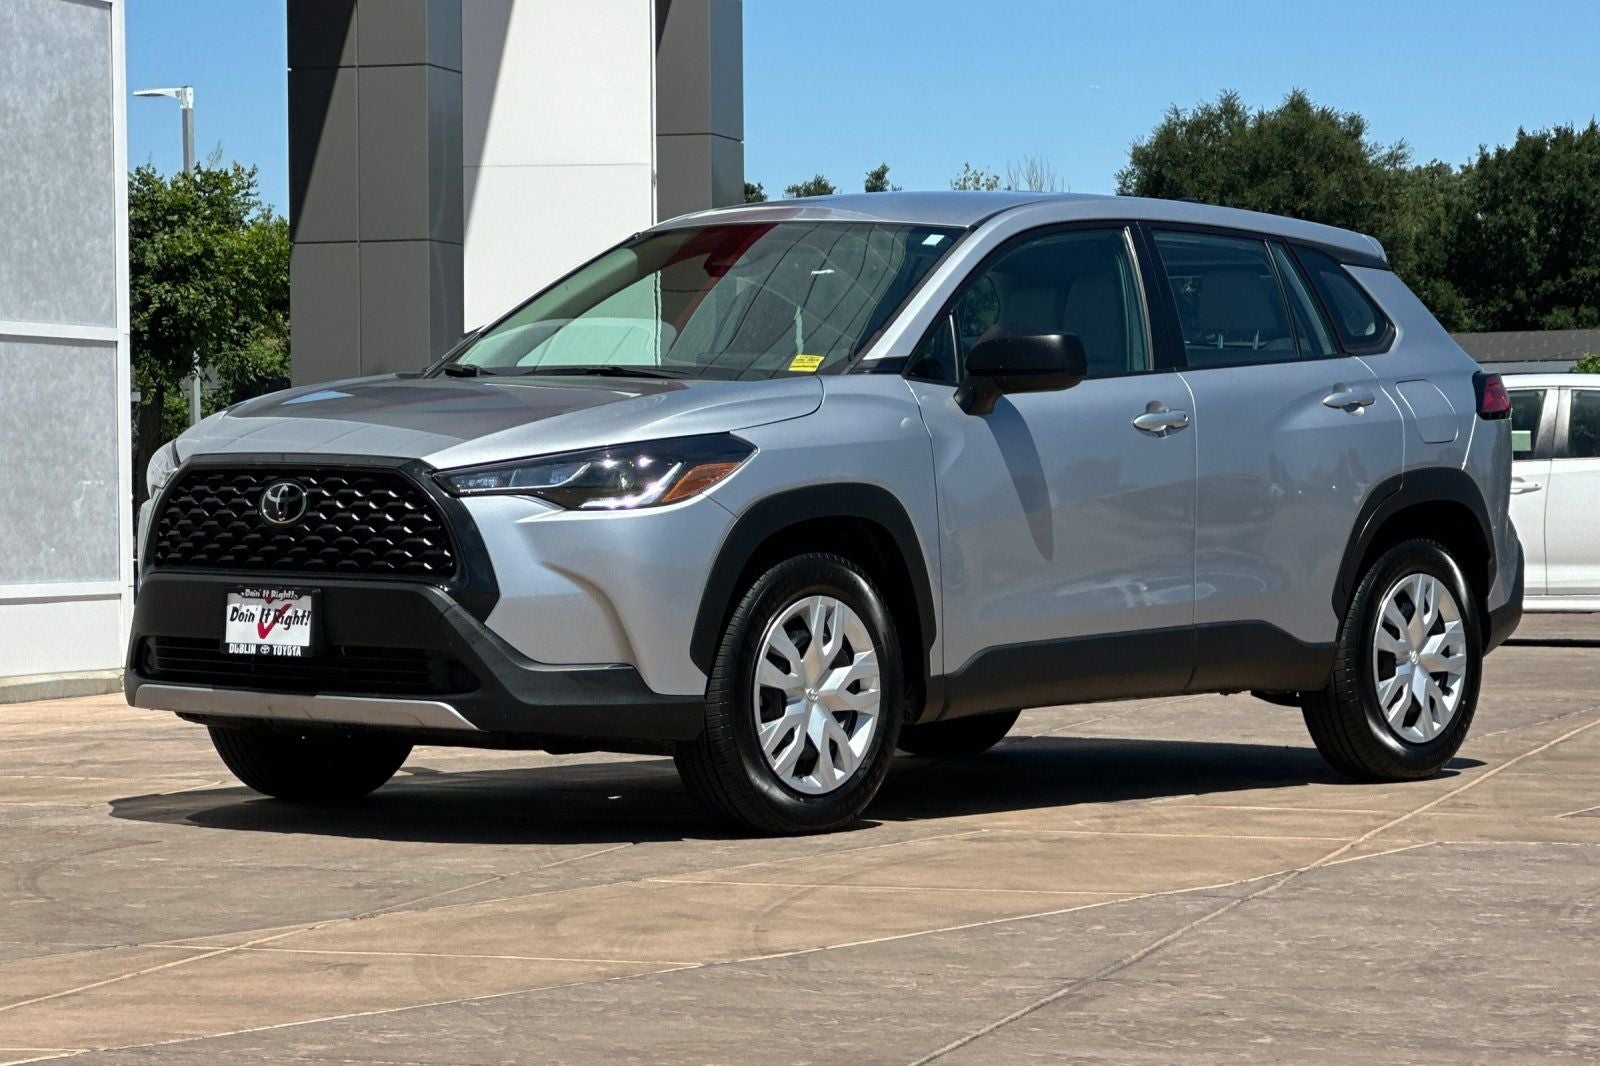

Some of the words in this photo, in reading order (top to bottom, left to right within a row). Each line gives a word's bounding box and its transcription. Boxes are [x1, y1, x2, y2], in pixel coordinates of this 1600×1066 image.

[259, 608, 271, 624] It
[273, 608, 311, 631] Right!
[228, 643, 257, 654] DUBLIN
[272, 645, 302, 657] TOYOTA
